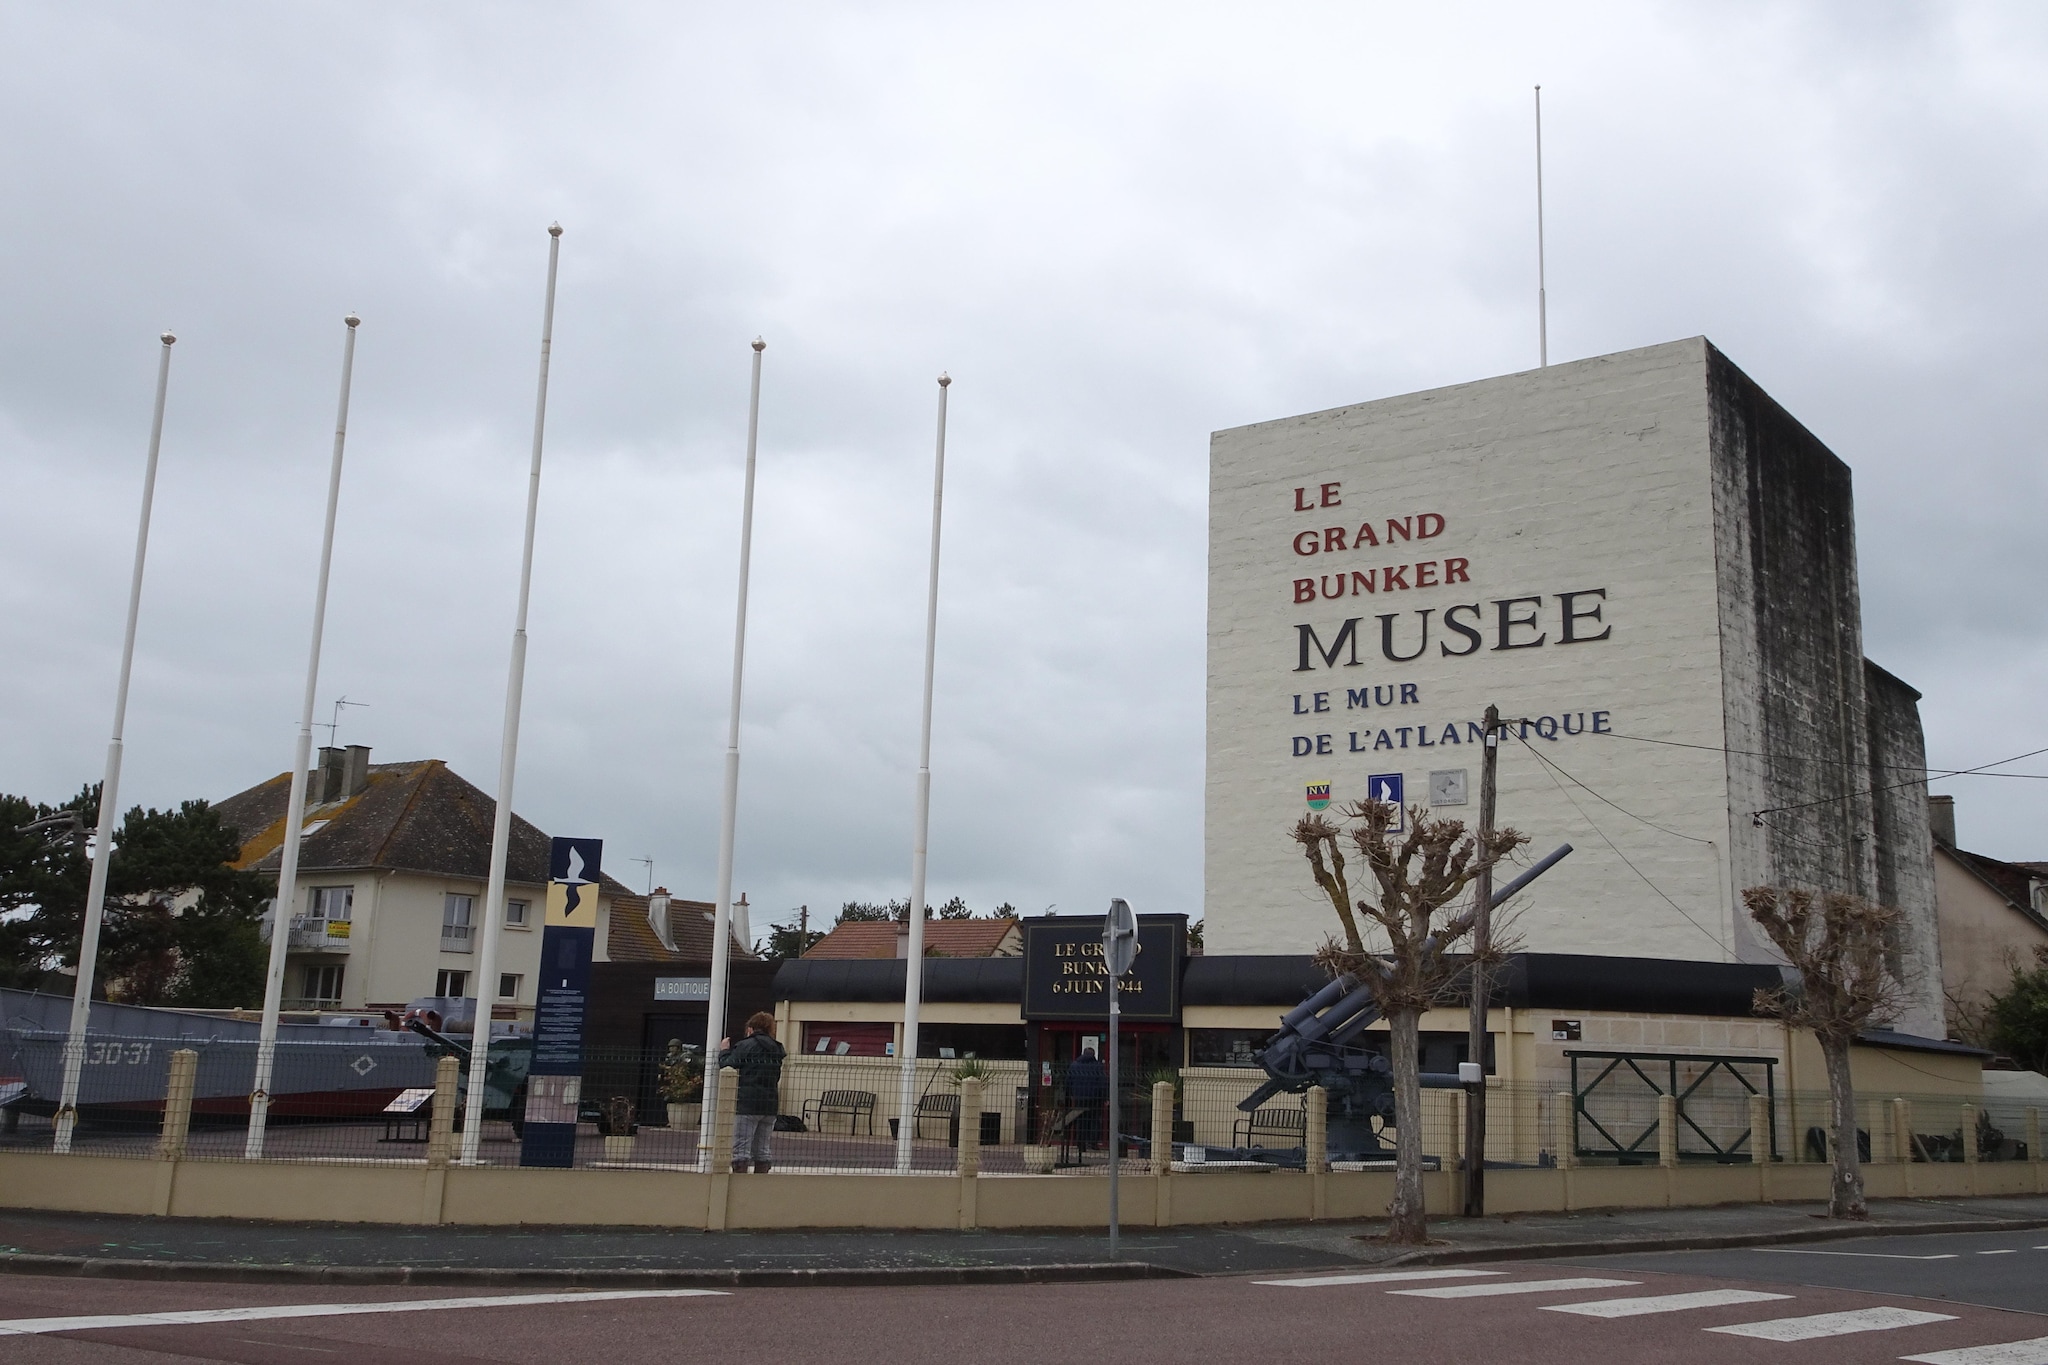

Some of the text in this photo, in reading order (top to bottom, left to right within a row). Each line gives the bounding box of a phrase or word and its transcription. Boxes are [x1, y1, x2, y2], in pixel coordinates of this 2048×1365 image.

[1294, 482, 1342, 512] LE
[1293, 513, 1446, 556] GRAND
[1292, 557, 1471, 604] BUNKER
[1292, 588, 1612, 672] MUSEE
[1293, 683, 1420, 715] LE MUR
[1292, 734, 1333, 757] DE
[1055, 943, 1076, 957] LE
[656, 983, 709, 994] LA BOUTIQUE
[1052, 980, 1143, 994] 6 JUIN 944
